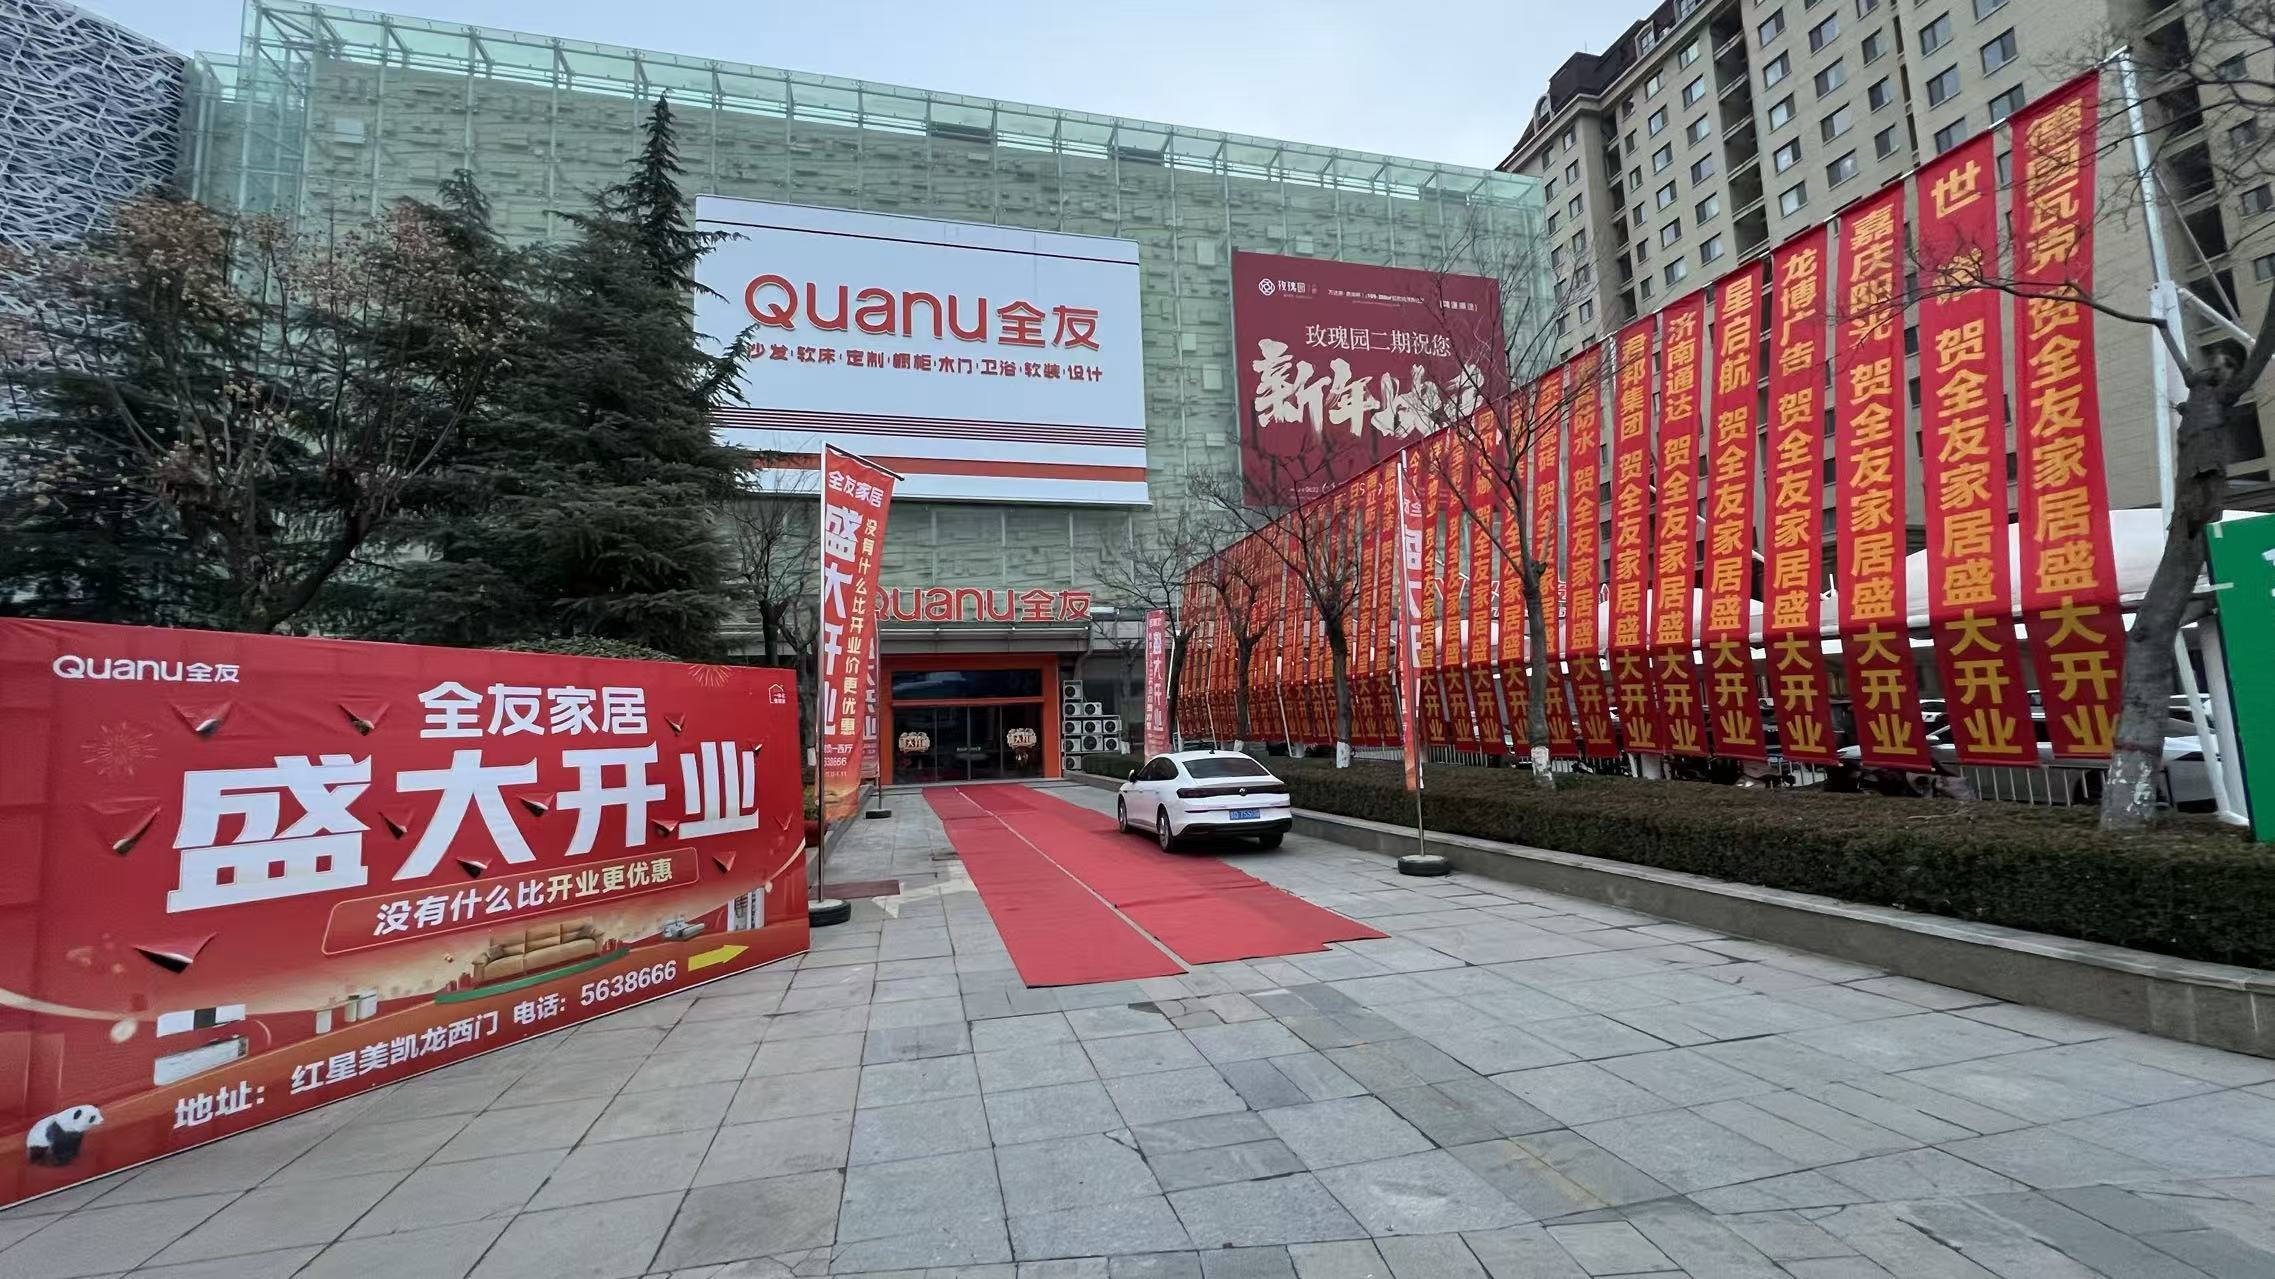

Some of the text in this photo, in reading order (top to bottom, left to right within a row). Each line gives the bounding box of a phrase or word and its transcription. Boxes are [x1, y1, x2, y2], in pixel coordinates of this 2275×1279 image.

[744, 274, 1100, 351] Quanu 全友
[1305, 324, 1450, 356] 玫瑰园二期祝您
[828, 470, 884, 508] 全友家居
[1656, 311, 1700, 751] 济南通达 贺全友家居盛大开业
[1708, 275, 1757, 745] 星启航 贺全友家居盛大开业
[1771, 249, 1826, 753] 龙博广告 贺全友家居盛大开业
[1849, 357, 1917, 754] 贺全友家居盛大开业
[1935, 318, 2022, 753] 贺全友家居盛大开业
[53, 654, 240, 684] Quanu 全友
[840, 519, 878, 735] 没有什么比开业价更优惠
[1021, 589, 1091, 621] 全友
[1571, 465, 1618, 744] 贺全友家居盛大开业
[1614, 449, 1656, 748] 贺全友家居盛大开业
[418, 681, 648, 740] 全友家居
[165, 740, 760, 913] 盛大开业
[375, 856, 674, 936] 没有什么比开业更优惠
[291, 1009, 500, 1096] 红星美凯龙西门
[580, 960, 677, 1008] 5638666
